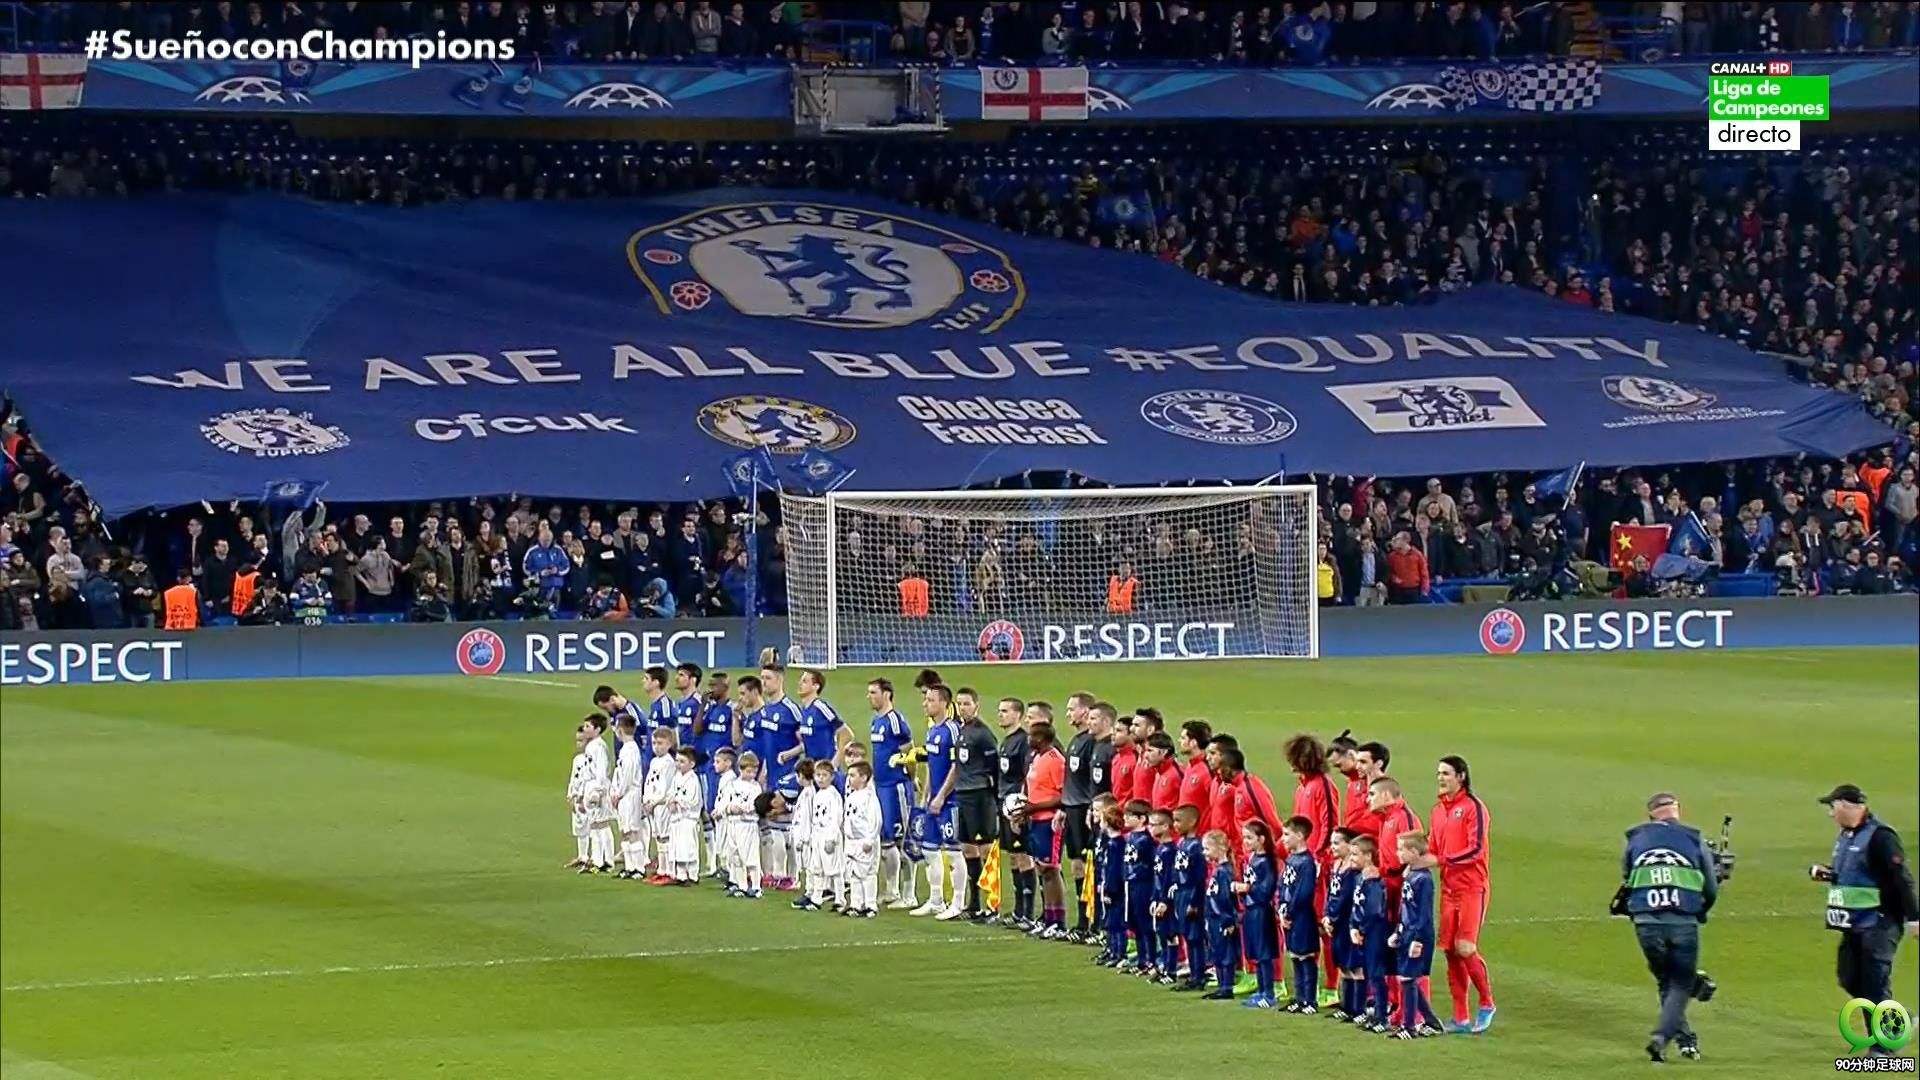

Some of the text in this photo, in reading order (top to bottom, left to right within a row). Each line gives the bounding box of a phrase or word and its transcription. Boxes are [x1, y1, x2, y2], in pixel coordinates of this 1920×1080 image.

[663, 206, 895, 242] CHELSEA
[130, 333, 1669, 392] WE ARE ALL BLUE #EQUALITY
[898, 395, 1082, 421] Chelsea
[922, 422, 1109, 445] FanCast
[1488, 612, 1515, 625] UEFA
[1543, 610, 1733, 651] RESPECT
[466, 632, 495, 644] UEFA
[526, 631, 725, 673] RESPECT
[1044, 622, 1234, 662] RESPECT
[1, 641, 183, 684] ESPECT
[1650, 867, 1672, 885] HB
[1647, 888, 1680, 908] 014
